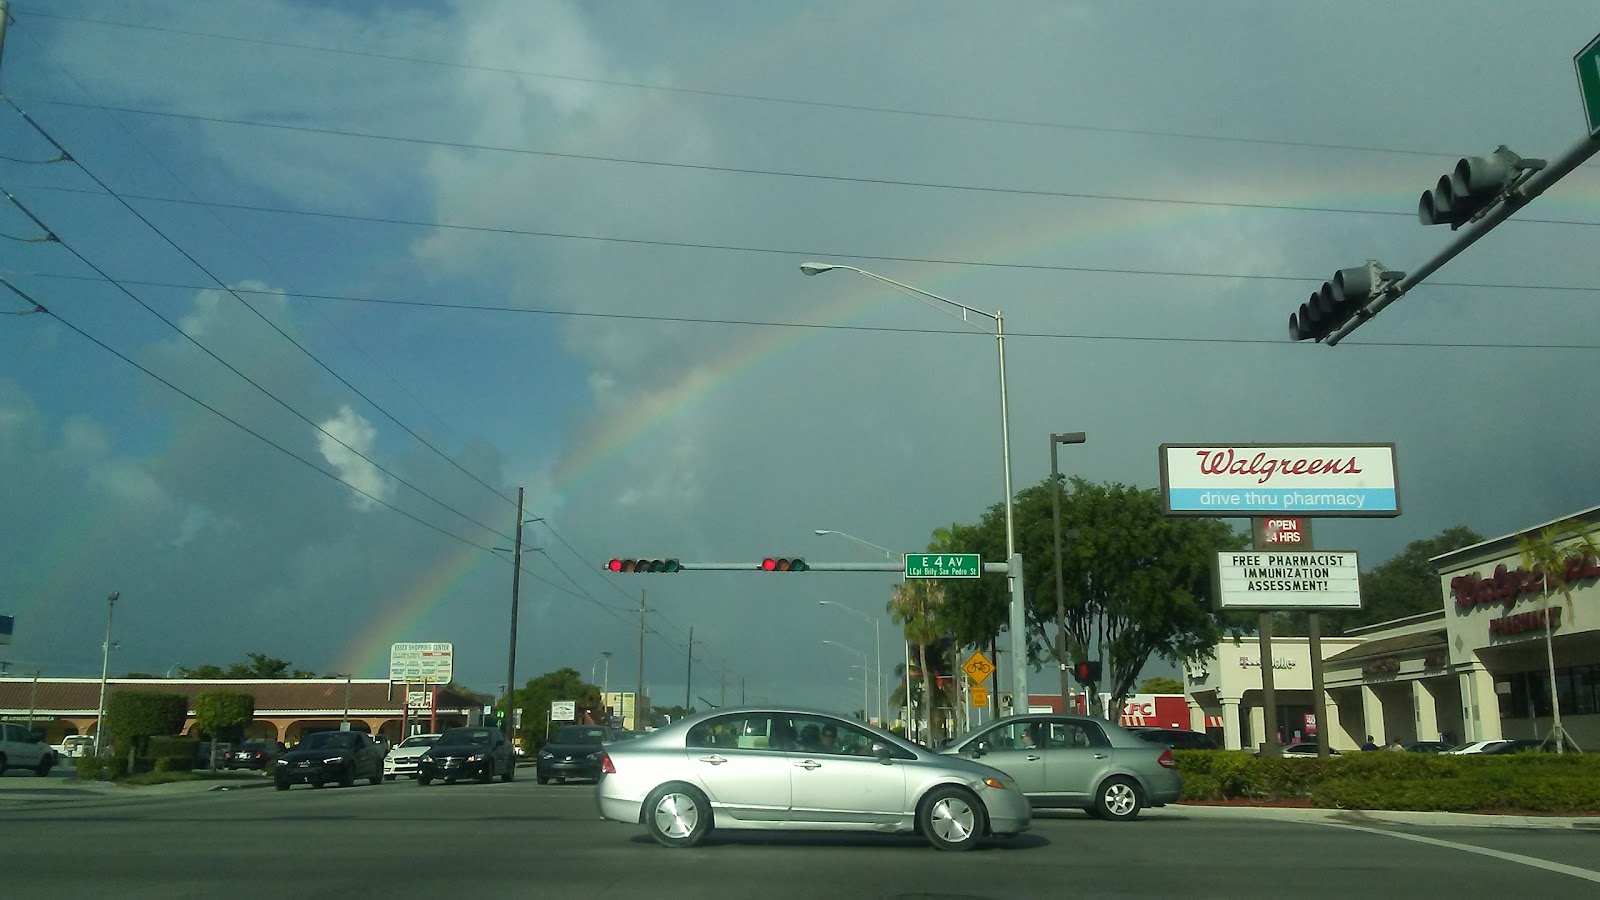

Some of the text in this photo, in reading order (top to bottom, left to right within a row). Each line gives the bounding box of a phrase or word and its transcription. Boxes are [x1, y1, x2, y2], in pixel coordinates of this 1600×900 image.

[1196, 449, 1362, 484] Walgreens
[1200, 491, 1365, 508] drive thru pharmacy
[1268, 520, 1297, 530] OPEN
[1266, 531, 1301, 542] 24 HRS
[922, 556, 963, 567] E 4 AV
[1232, 555, 1344, 566] FREE PHARMACIST
[924, 567, 937, 576] Billy
[939, 567, 950, 576] San
[951, 567, 968, 576] Pedro
[970, 567, 977, 576] St
[1243, 568, 1329, 578] IMMUNIZATION
[1247, 580, 1328, 591] ASSESSMENT!
